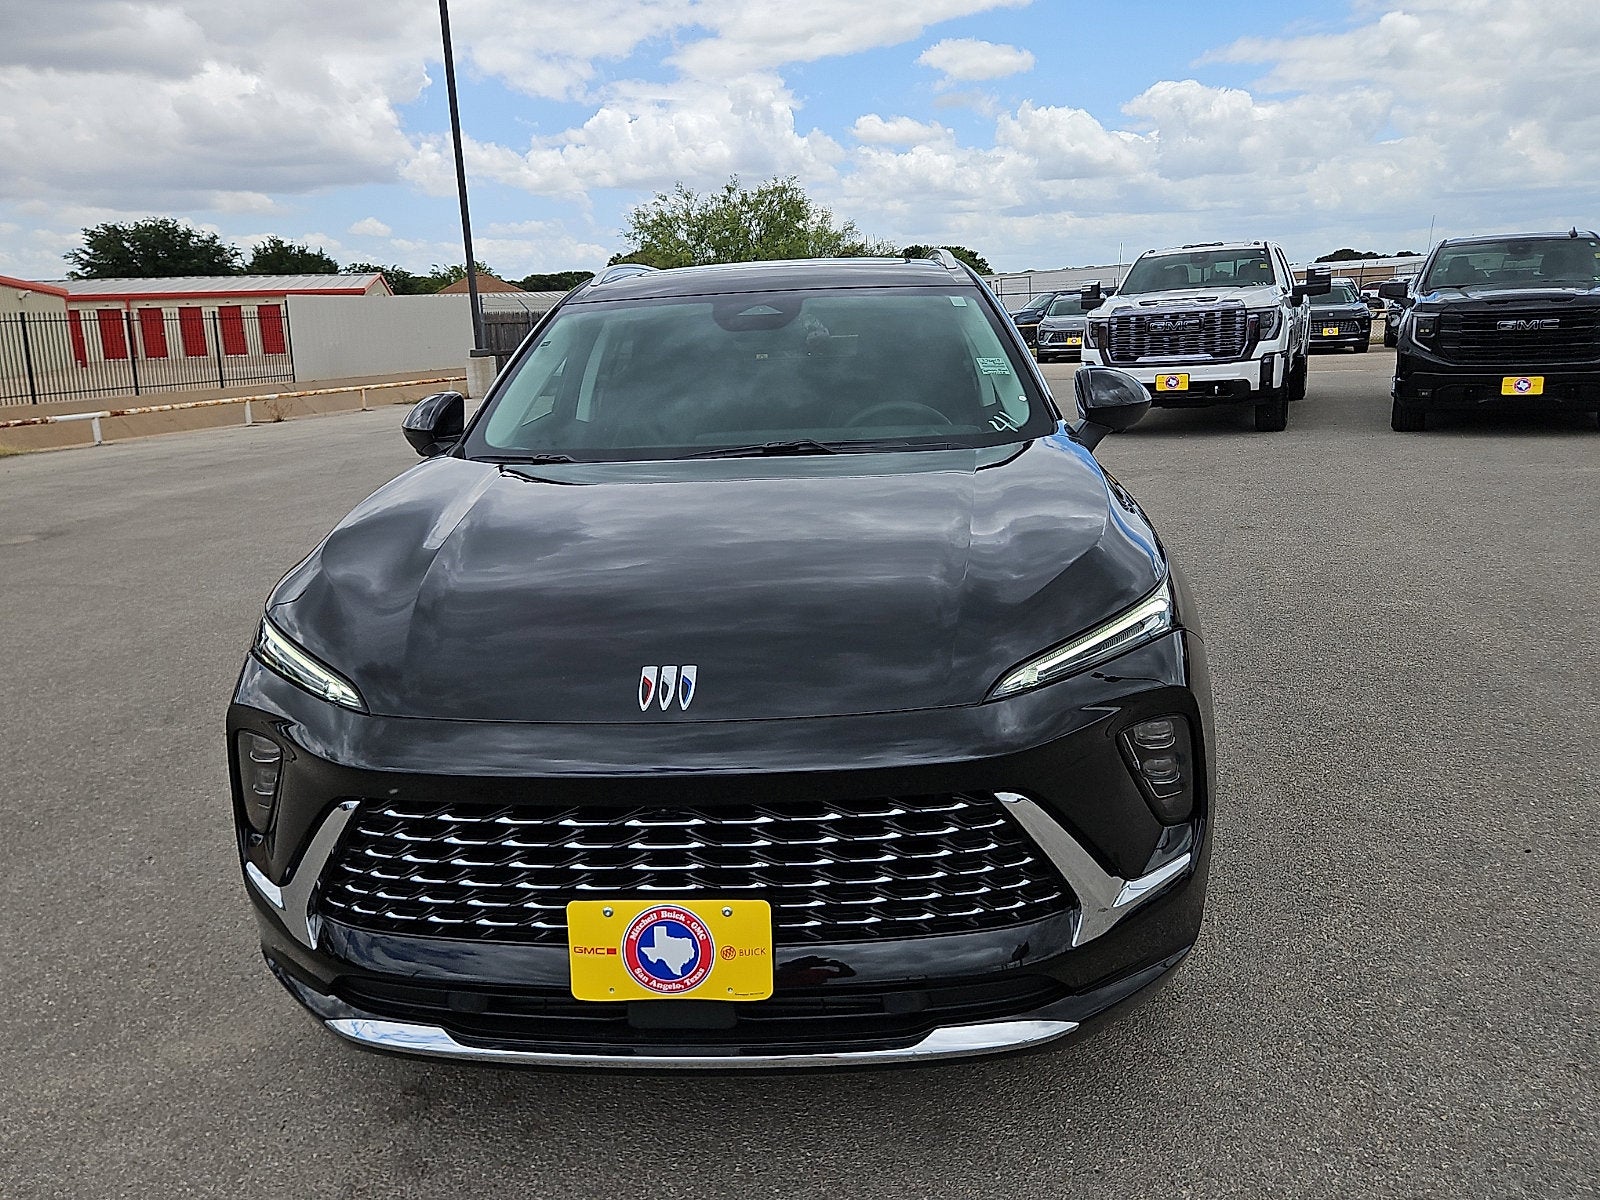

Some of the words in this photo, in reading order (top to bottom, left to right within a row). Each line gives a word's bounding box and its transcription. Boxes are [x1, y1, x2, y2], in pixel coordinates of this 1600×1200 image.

[1149, 320, 1200, 332] GMC
[1496, 319, 1560, 330] GMC
[629, 912, 658, 941] Mitchell
[660, 910, 686, 922] Buick
[690, 921, 707, 941] GMC
[573, 946, 606, 955] GMC
[738, 947, 766, 957] BUICK
[634, 967, 649, 983] San
[649, 979, 685, 991] Angelo,
[683, 967, 705, 986] Texas
